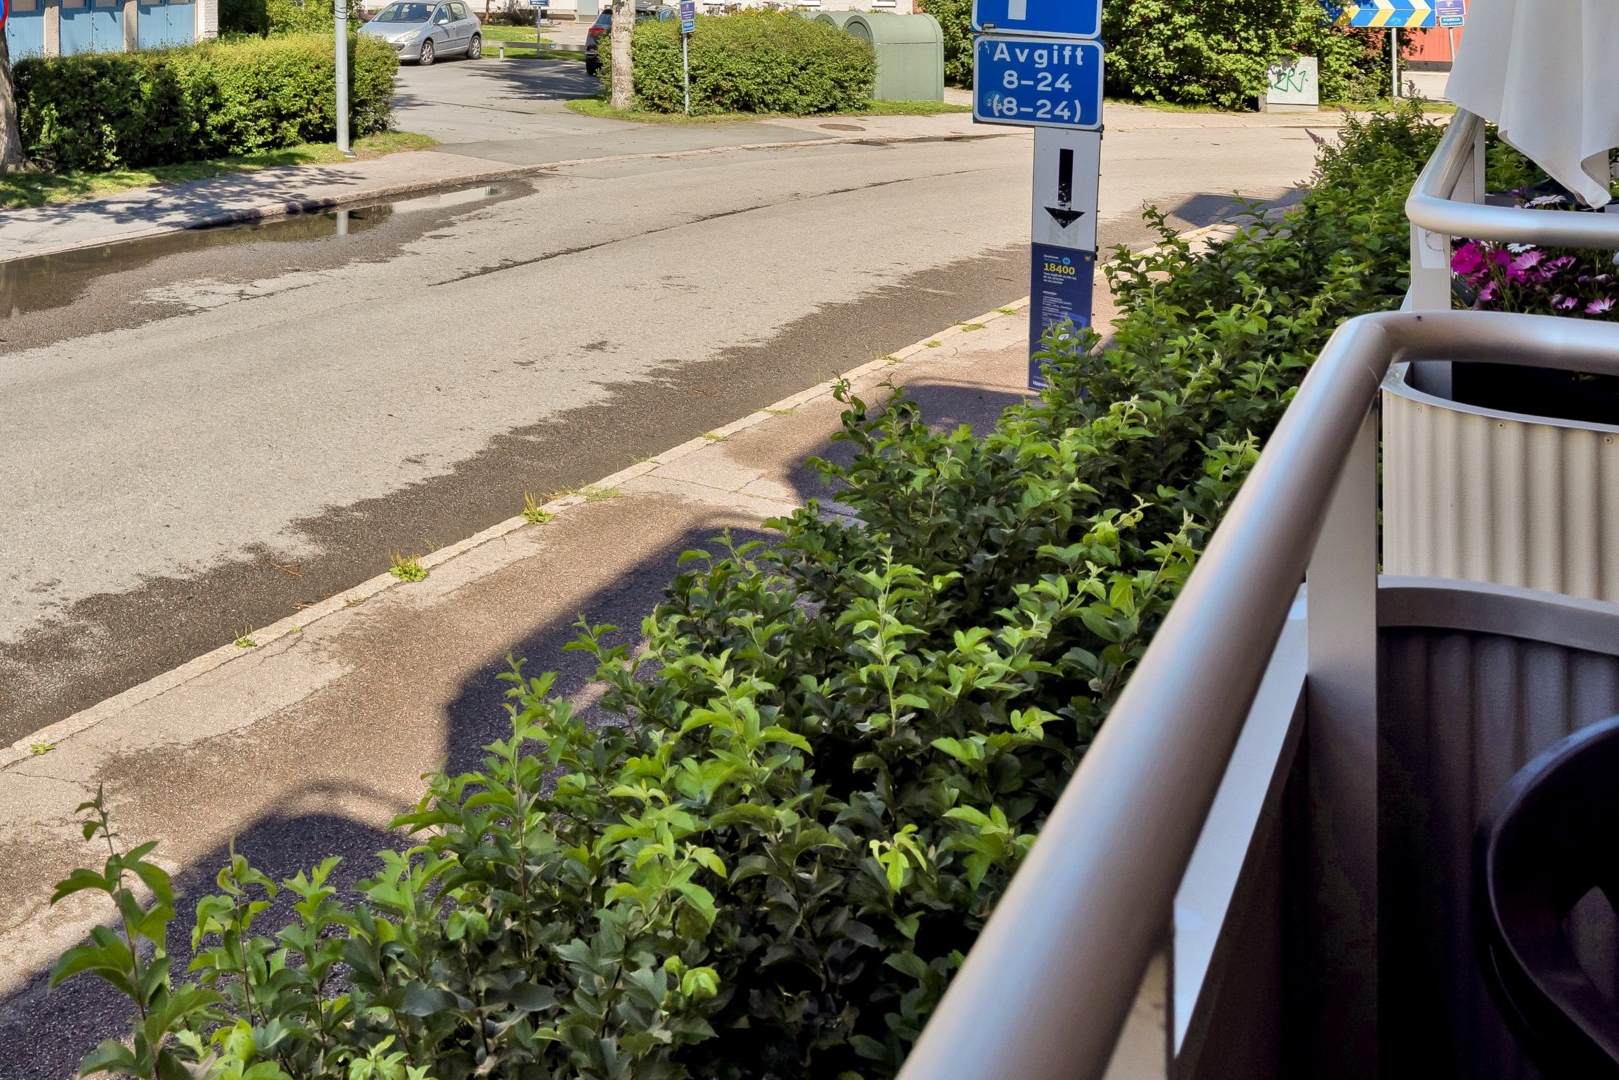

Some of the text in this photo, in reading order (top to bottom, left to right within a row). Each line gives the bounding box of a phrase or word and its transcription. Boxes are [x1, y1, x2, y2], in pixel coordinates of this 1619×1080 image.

[993, 42, 1084, 68] Avgift
[1002, 69, 1073, 93] 8-24
[992, 94, 1081, 124] (8-24)
[1043, 262, 1076, 275] 18400
